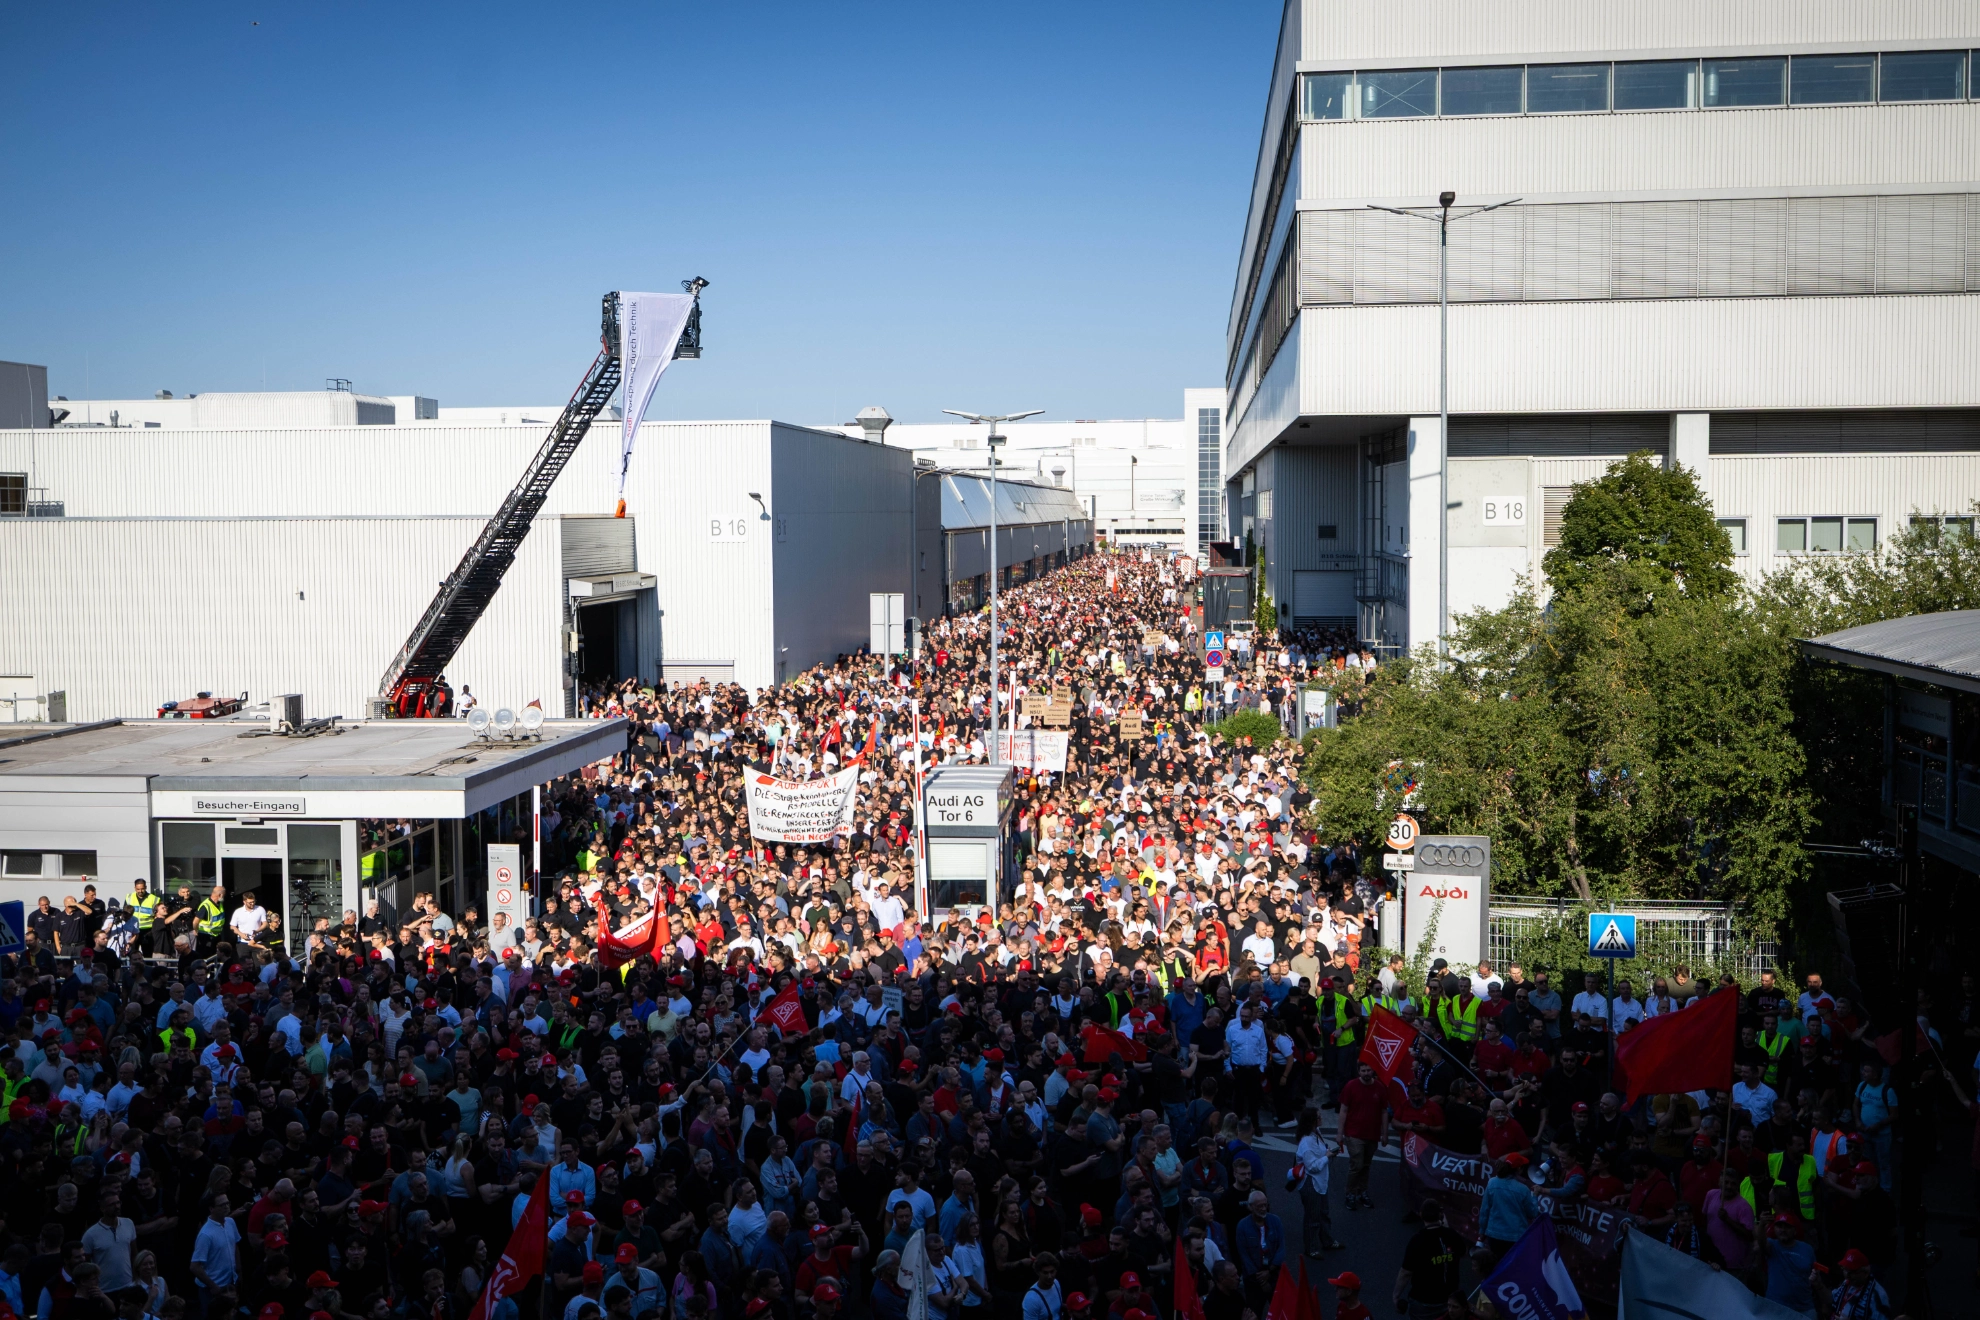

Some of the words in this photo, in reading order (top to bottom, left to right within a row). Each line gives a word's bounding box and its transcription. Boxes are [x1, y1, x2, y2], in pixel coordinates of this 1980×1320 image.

[629, 301, 638, 336] Technik
[629, 337, 637, 364] durch
[627, 366, 636, 413] Vorsprung
[1486, 502, 1497, 520] B
[1504, 502, 1523, 520] 18
[711, 519, 722, 536] B
[728, 519, 746, 536] 16
[775, 780, 799, 790] AUDI
[802, 776, 839, 790] SPORT
[197, 801, 300, 812] Besucher-Eingang
[927, 795, 959, 807] Audi
[963, 795, 984, 807] AG
[938, 809, 961, 822] Tor
[965, 810, 974, 822] 6
[783, 833, 805, 841] AUDI
[1390, 823, 1412, 840] 30
[1419, 885, 1468, 901] Audi
[1758, 996, 1779, 1008] BULLS
[1442, 1177, 1486, 1197] STAND
[1431, 1253, 1454, 1266] 1975
